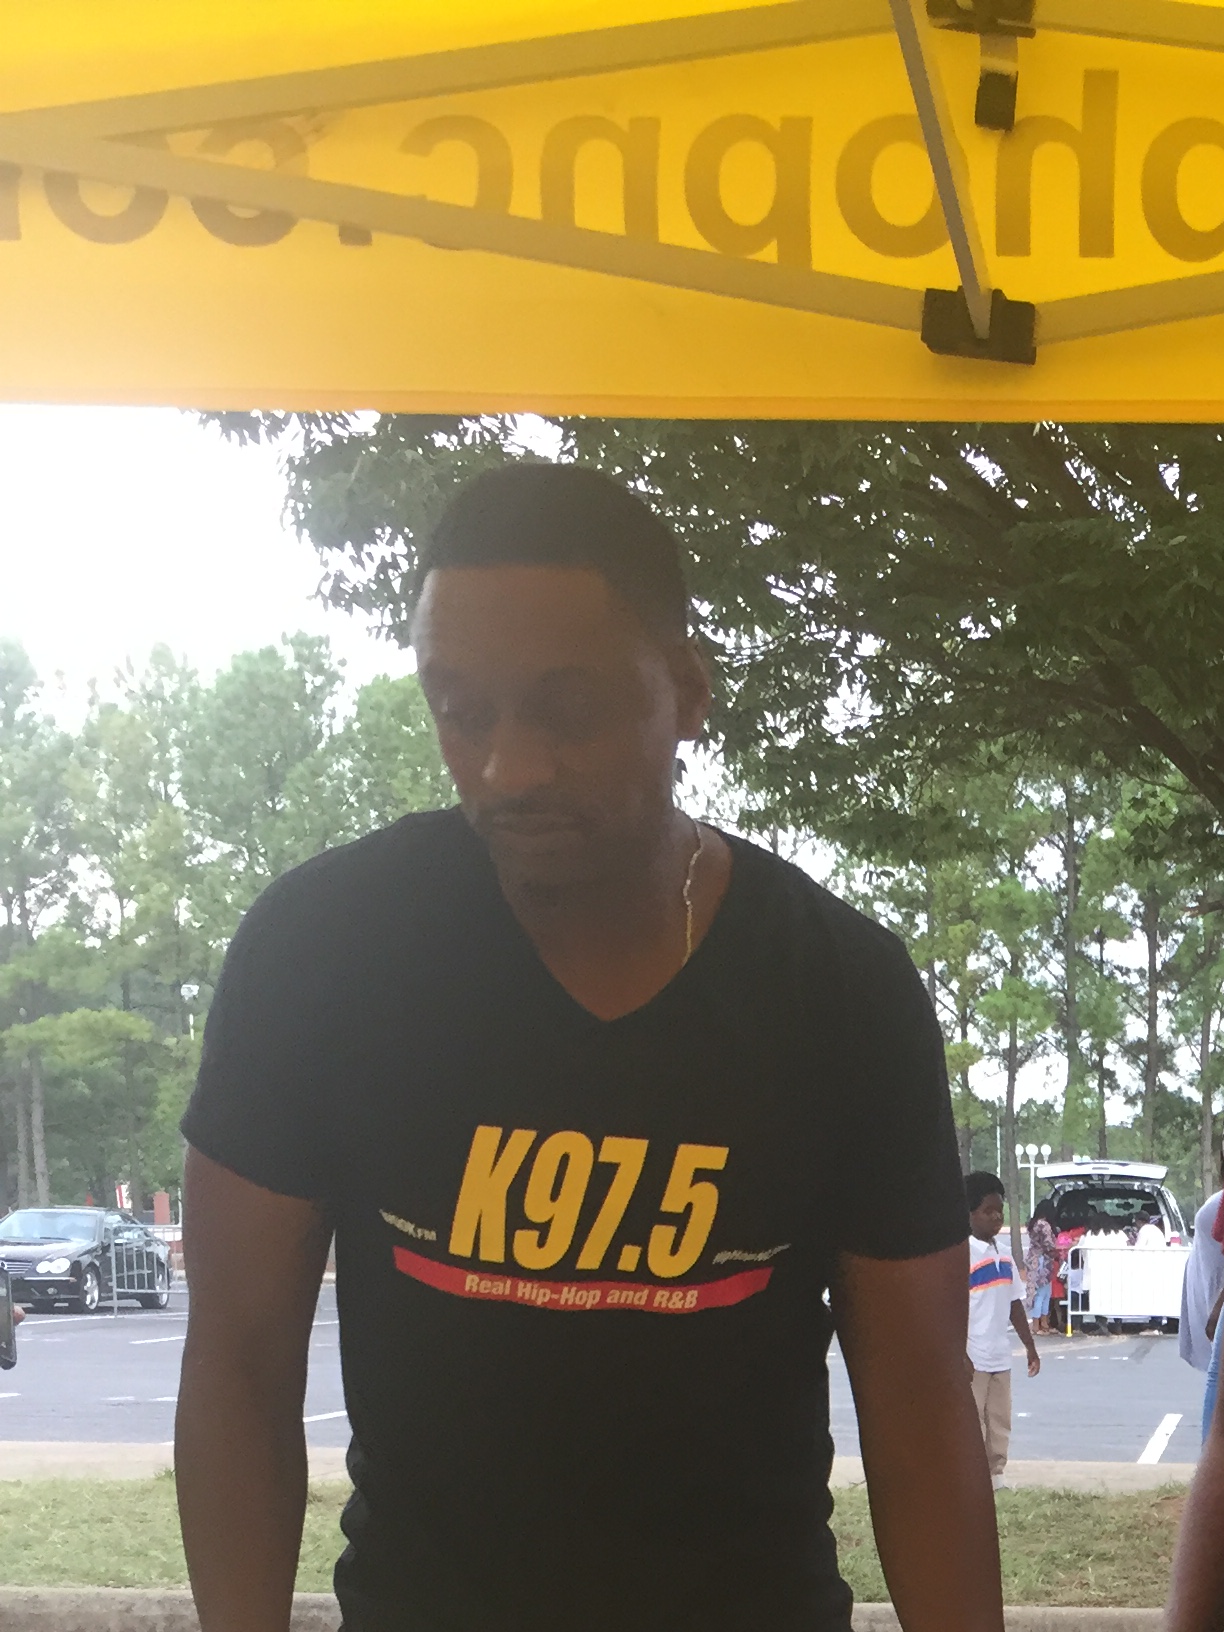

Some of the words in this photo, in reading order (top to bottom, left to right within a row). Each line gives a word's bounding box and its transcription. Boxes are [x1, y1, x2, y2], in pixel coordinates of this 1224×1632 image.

[449, 1125, 730, 1279] K97.5
[464, 1274, 511, 1296] Real
[516, 1281, 602, 1309] Hip-Hop
[605, 1287, 649, 1307] and
[653, 1289, 699, 1309] R&B
